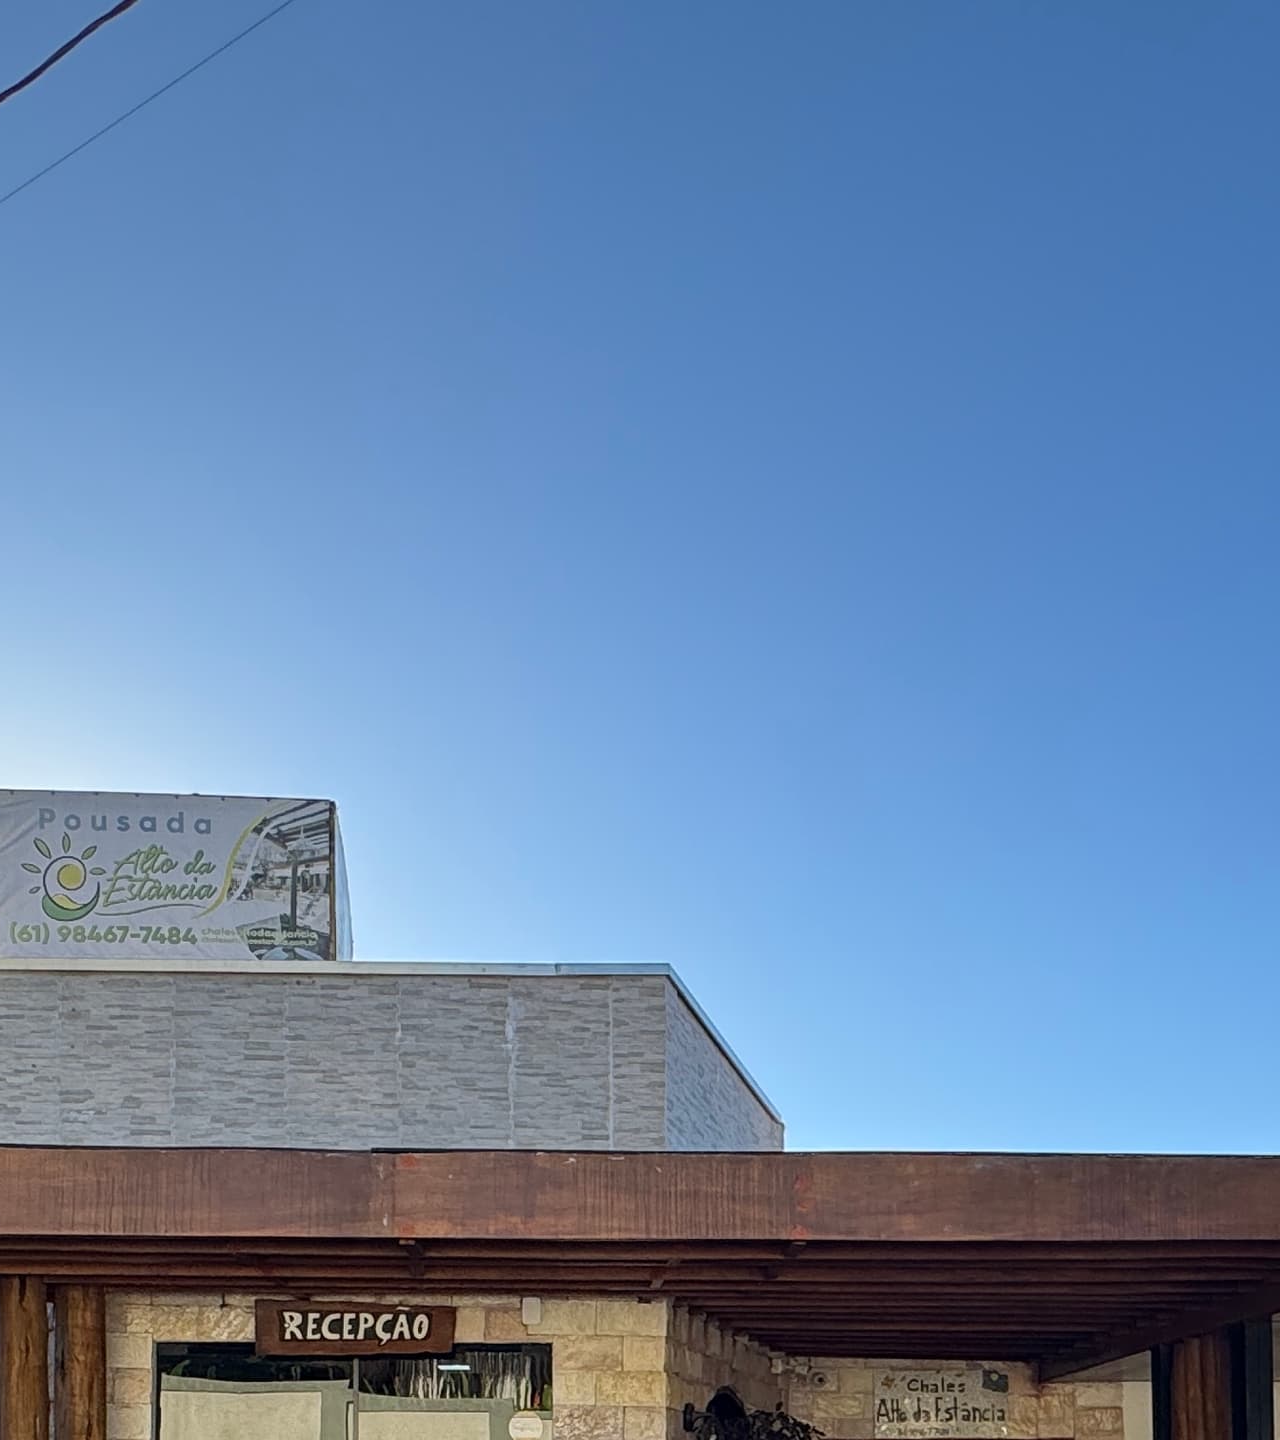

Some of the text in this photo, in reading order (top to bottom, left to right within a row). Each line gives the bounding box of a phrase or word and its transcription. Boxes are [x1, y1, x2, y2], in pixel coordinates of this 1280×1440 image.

[38, 808, 212, 834] Pousada
[113, 844, 216, 876] Alto da
[102, 873, 218, 907] Estância
[10, 922, 198, 945] (61) 98467-7484
[282, 1306, 430, 1346] RECEPÇÃO
[877, 1396, 1007, 1423] Alto da Estância
